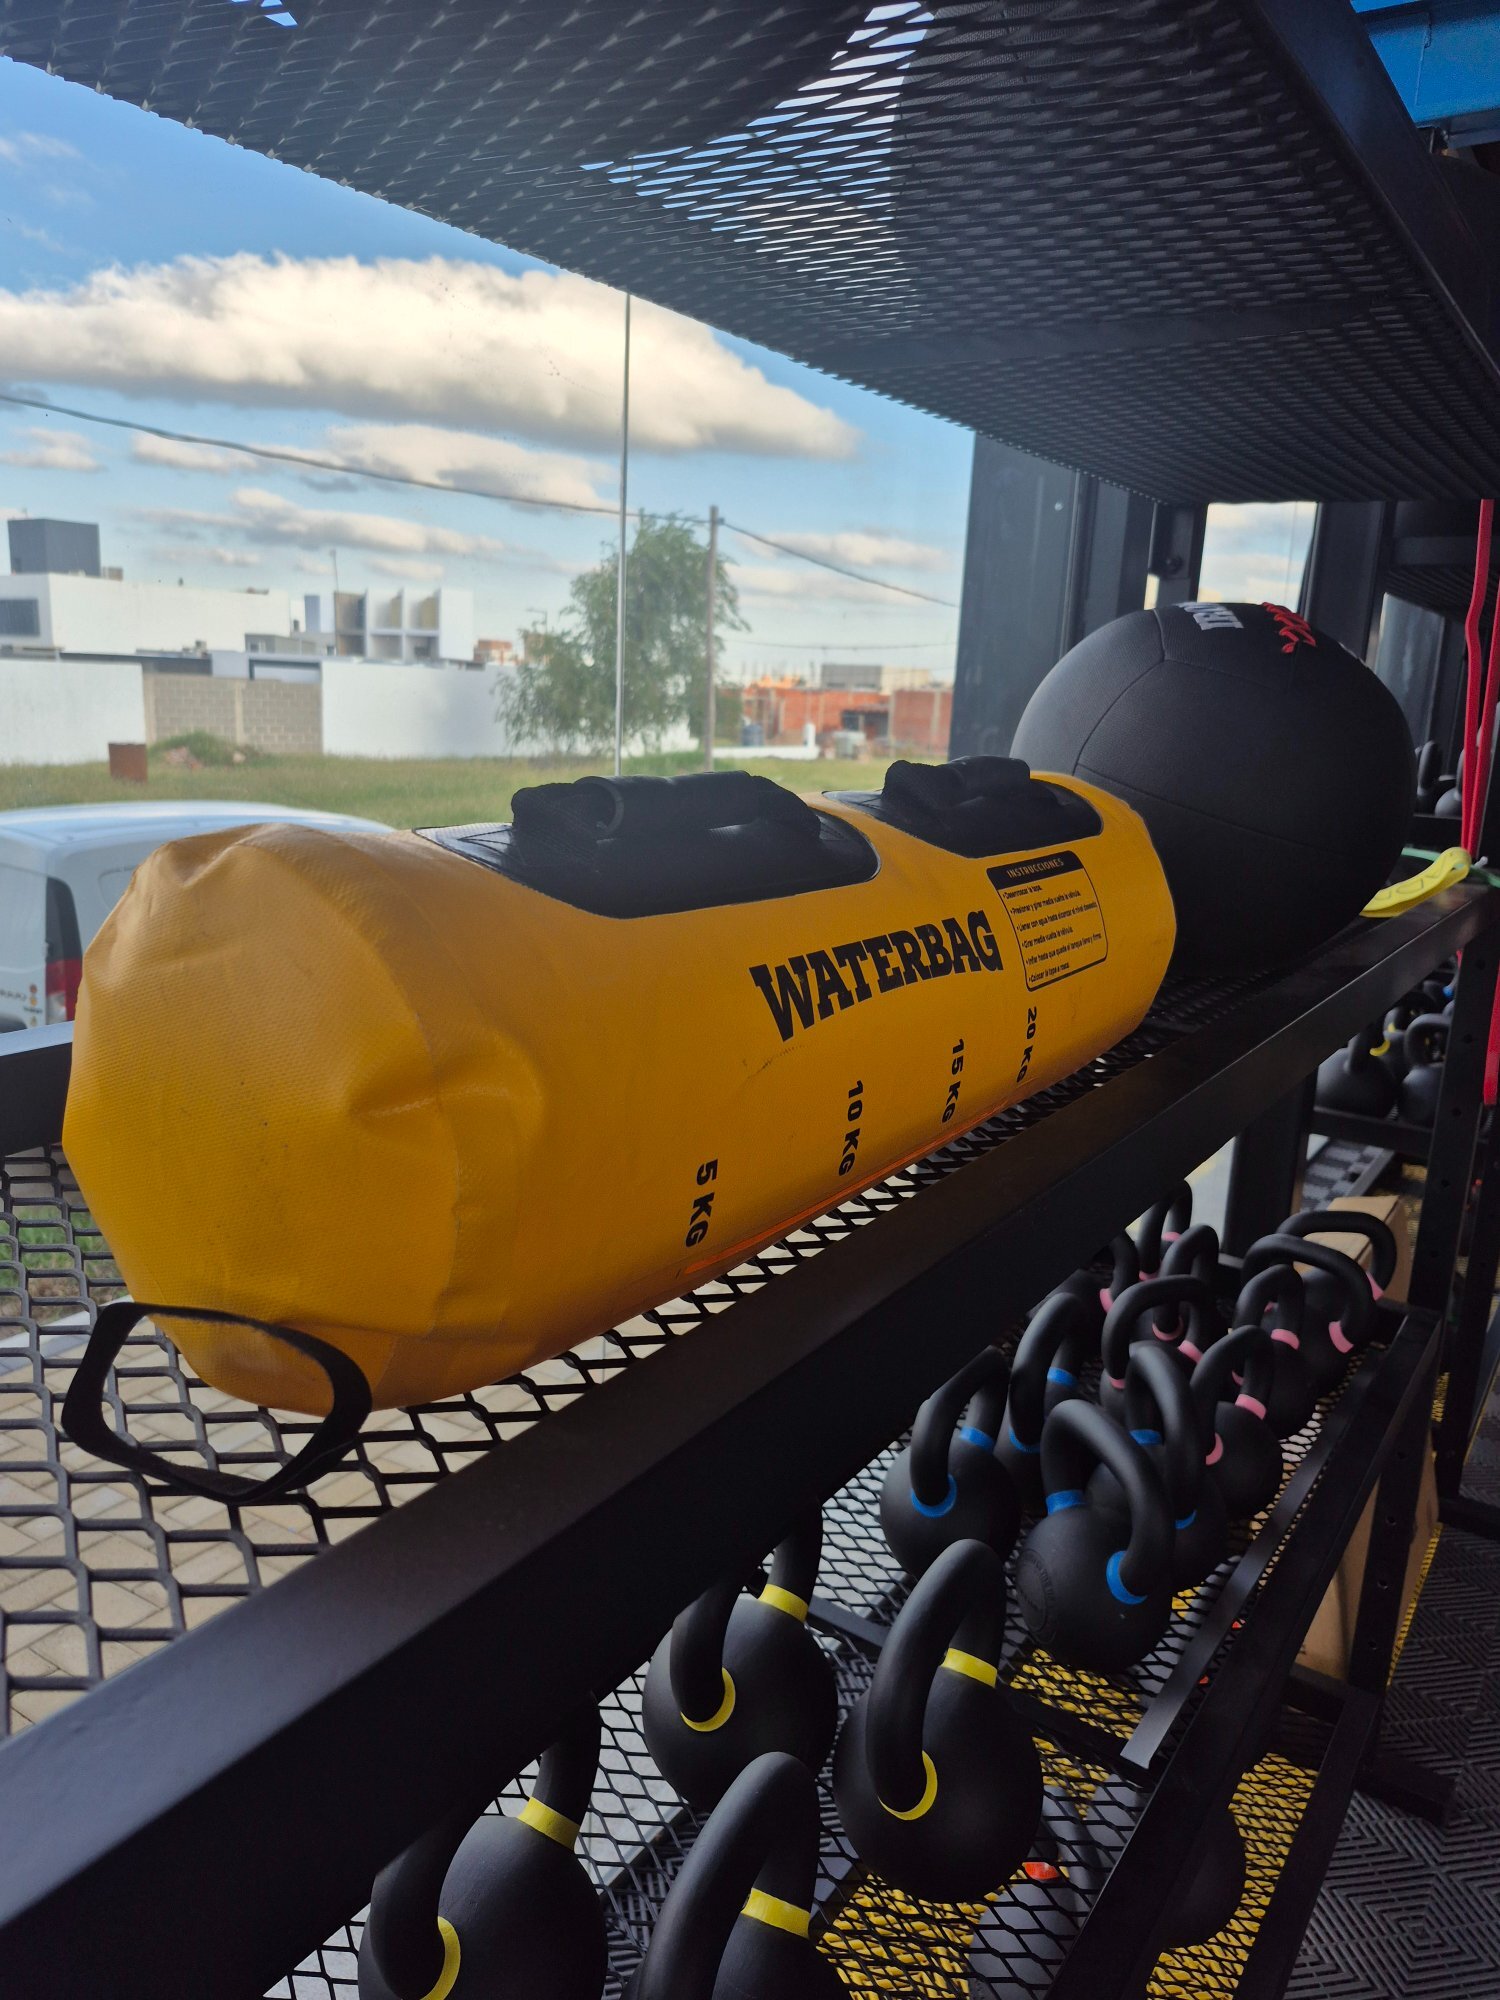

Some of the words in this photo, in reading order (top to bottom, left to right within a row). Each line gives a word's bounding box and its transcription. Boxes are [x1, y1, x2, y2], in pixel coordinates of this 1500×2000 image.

[749, 910, 1003, 1042] WATERBAG
[1026, 1006, 1038, 1040] 20
[951, 1038, 965, 1076] 15
[1016, 1044, 1034, 1083] KG
[847, 1080, 864, 1122] 10
[941, 1080, 961, 1124] KG
[696, 1158, 719, 1186] 5
[837, 1127, 861, 1177] KG
[684, 1192, 715, 1249] KG
